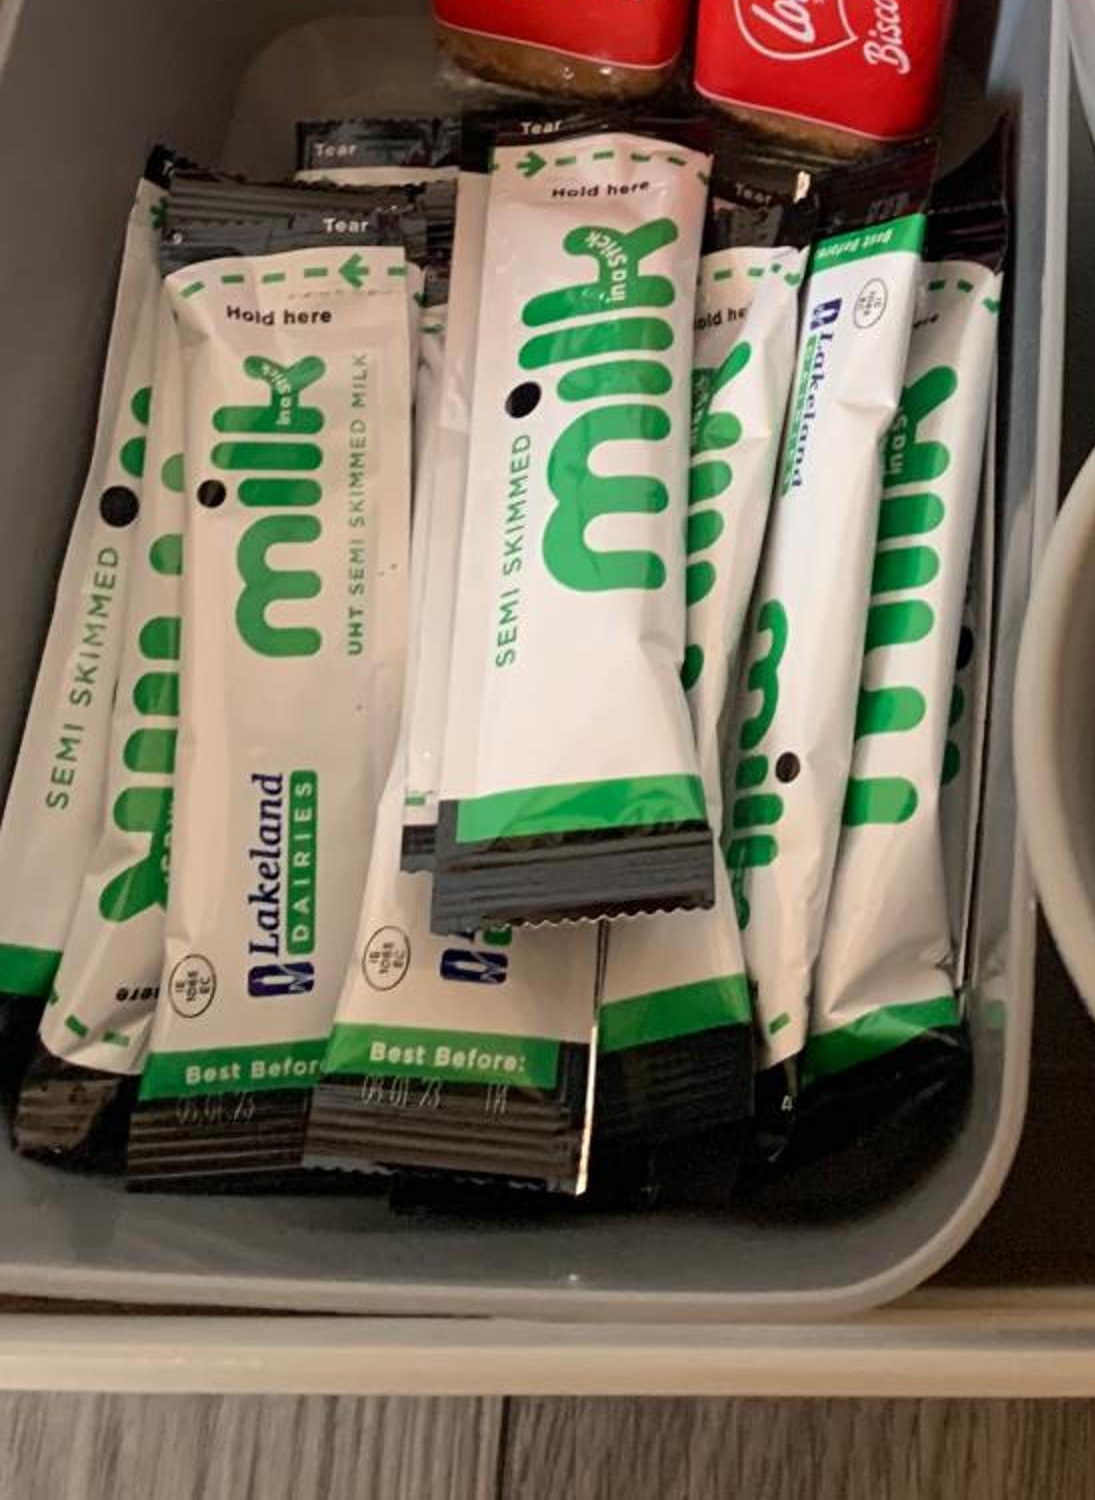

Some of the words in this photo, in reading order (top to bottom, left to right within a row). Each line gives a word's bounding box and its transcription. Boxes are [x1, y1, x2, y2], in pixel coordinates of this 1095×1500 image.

[314, 142, 358, 158] Tear
[522, 120, 562, 135] Tear
[551, 184, 600, 199] Hold
[606, 180, 650, 196] here
[323, 217, 369, 234] Tear
[226, 305, 275, 326] Hold
[283, 307, 332, 325] here
[351, 352, 367, 409] MILK
[505, 218, 678, 592] milk
[350, 419, 367, 527] SKIMMED
[197, 355, 326, 658] milk
[504, 434, 531, 577] SKIMMED
[349, 536, 366, 597] SEMI
[348, 605, 363, 655] UHT
[496, 592, 519, 668] SEMI
[47, 724, 84, 810] SEMI
[70, 547, 119, 707] SKIMMED
[248, 773, 284, 956] Lakeland
[291, 780, 314, 943] DAIRIES
[185, 1063, 240, 1085] Best
[251, 1059, 321, 1079] Befor
[370, 1041, 424, 1064] Best
[434, 1046, 526, 1072] Before:
